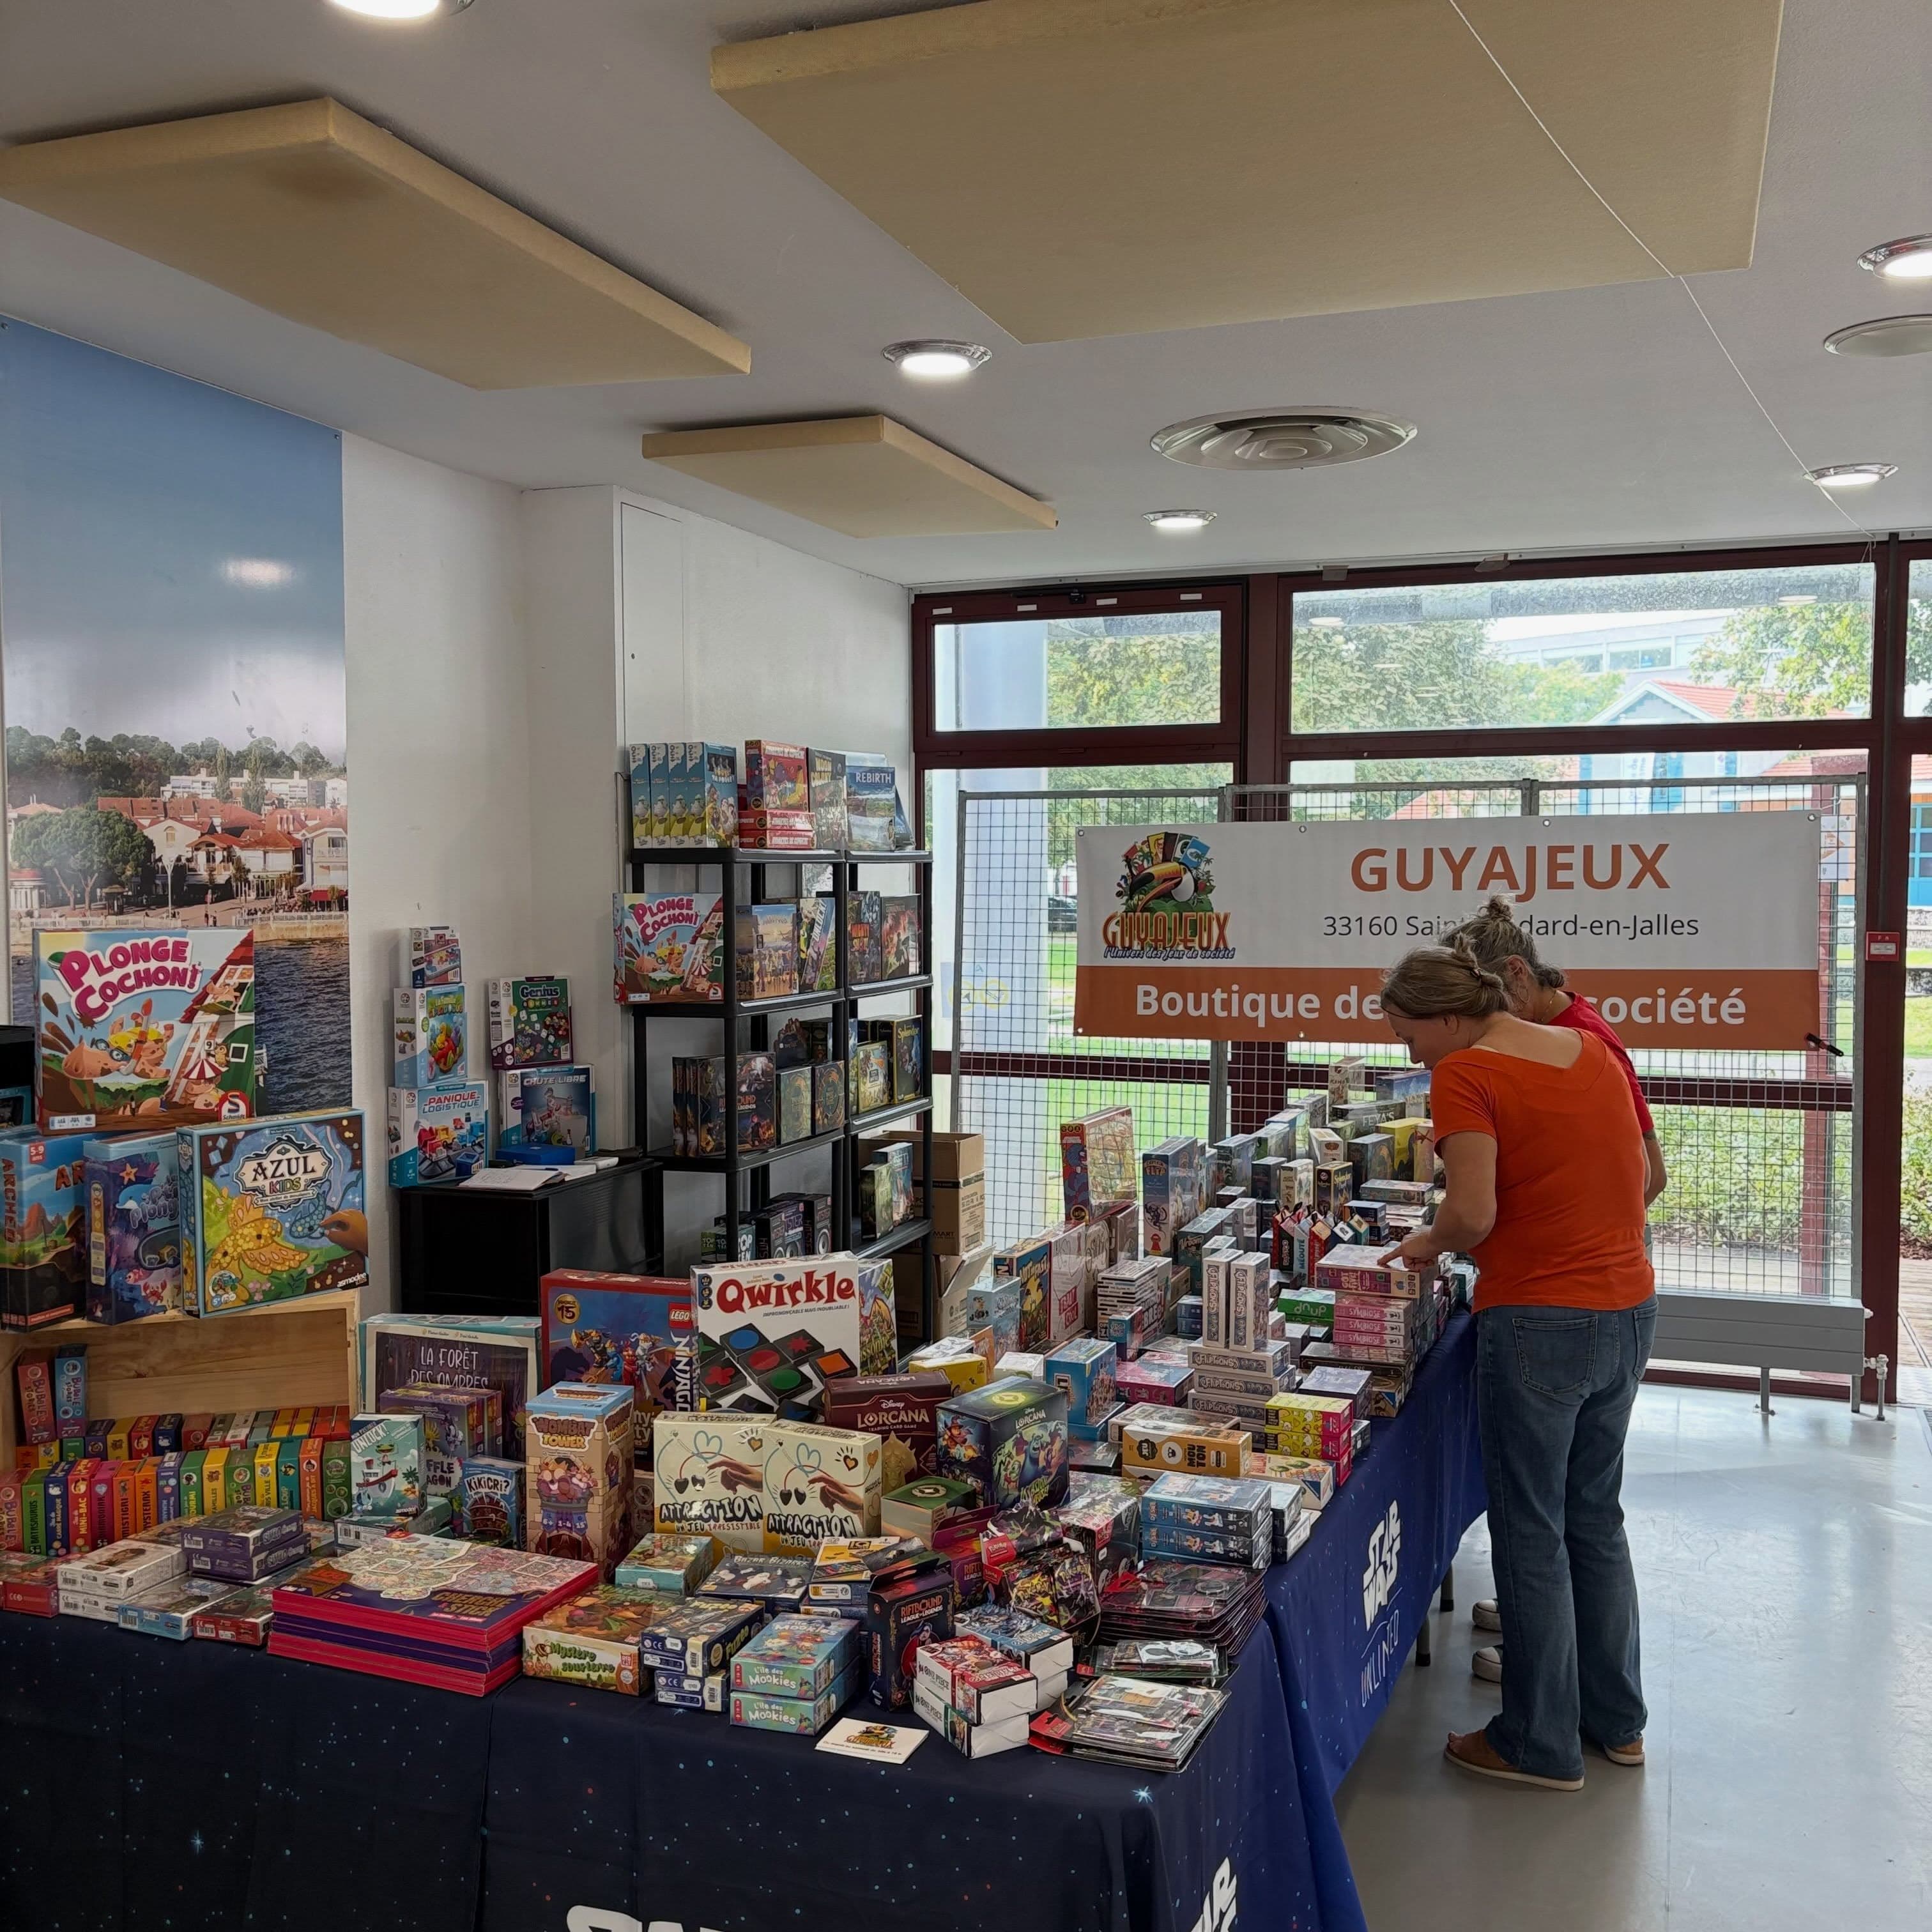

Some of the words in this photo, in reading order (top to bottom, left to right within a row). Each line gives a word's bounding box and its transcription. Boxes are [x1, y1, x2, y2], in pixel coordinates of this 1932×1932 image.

[855, 771, 892, 784] REBIRTH
[1351, 843, 1671, 903] GUYAJEUX
[633, 897, 694, 926] PLONGE
[1102, 911, 1231, 950] GUYAJEUX
[1323, 916, 1398, 937] 33160
[1146, 947, 1162, 958] des
[1186, 947, 1199, 958] de
[1200, 946, 1236, 959] société
[59, 939, 189, 992] PLONGE
[75, 963, 199, 1020] COCHON!
[519, 984, 560, 999] Genius
[1136, 984, 1321, 1028] Boutique
[897, 1023, 920, 1043] Splendor
[523, 1077, 556, 1086] CHUTE
[558, 1075, 587, 1084] LIBRE
[422, 1099, 480, 1114] LOGISTIQUE
[428, 1091, 477, 1106] PANIQUE
[252, 1155, 317, 1182] AZUL
[269, 1177, 302, 1195] KIDS
[716, 1268, 856, 1314] Qwirkle
[557, 1305, 576, 1320] 15
[670, 1308, 691, 1321] LEGO
[1349, 1307, 1381, 1319] SYMBIOSE
[1349, 1319, 1381, 1331] SYMBIOSE
[1349, 1332, 1381, 1344] SYMBIOSE
[421, 1346, 434, 1366] LA
[439, 1347, 479, 1370] FORÊT
[33, 1378, 47, 1417] BUBBLE
[71, 1376, 82, 1406] BUBBLE
[531, 1416, 595, 1436] WOMBAT
[857, 1408, 930, 1429] LORCANA
[1015, 1410, 1046, 1429] LORCANA
[351, 1423, 391, 1454] UNLOCK!
[542, 1434, 586, 1449] TOWER
[79, 1497, 88, 1534] MINI-BAC
[660, 1494, 763, 1524] ATTRACTION
[675, 1522, 687, 1533] UN
[687, 1521, 705, 1532] JEU
[767, 1513, 858, 1540] ATTRACTION
[790, 1536, 806, 1548] JEU
[1363, 1499, 1400, 1591] STAR
[733, 1555, 765, 1565] BAZAR
[768, 1556, 809, 1567] BIZARRE
[445, 1602, 501, 1616] STICK
[900, 1595, 943, 1618] RIFTBOUND
[900, 1613, 919, 1624] LEAGUE
[922, 1604, 944, 1617] LEGENDS
[549, 1641, 597, 1662] Mystère
[749, 1674, 797, 1690] Mookies
[747, 1710, 797, 1727] Mookies
